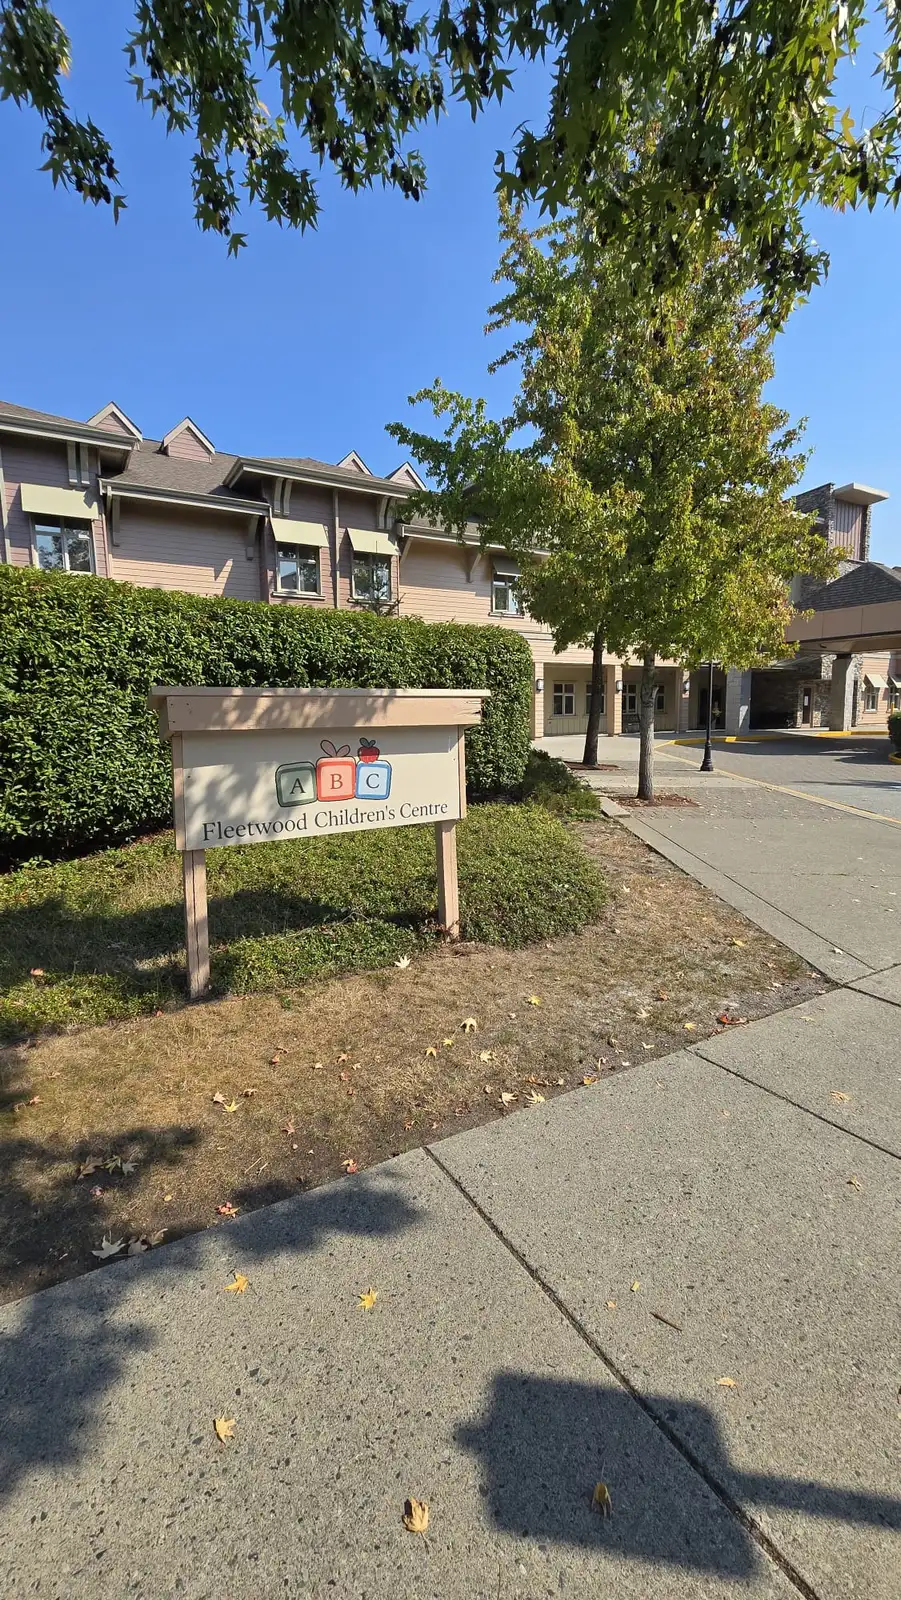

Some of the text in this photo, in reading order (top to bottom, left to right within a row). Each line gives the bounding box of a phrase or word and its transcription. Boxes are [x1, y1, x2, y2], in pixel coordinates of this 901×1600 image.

[290, 773, 380, 795] A B C
[202, 801, 448, 842] Fleetwood Children's Centre
